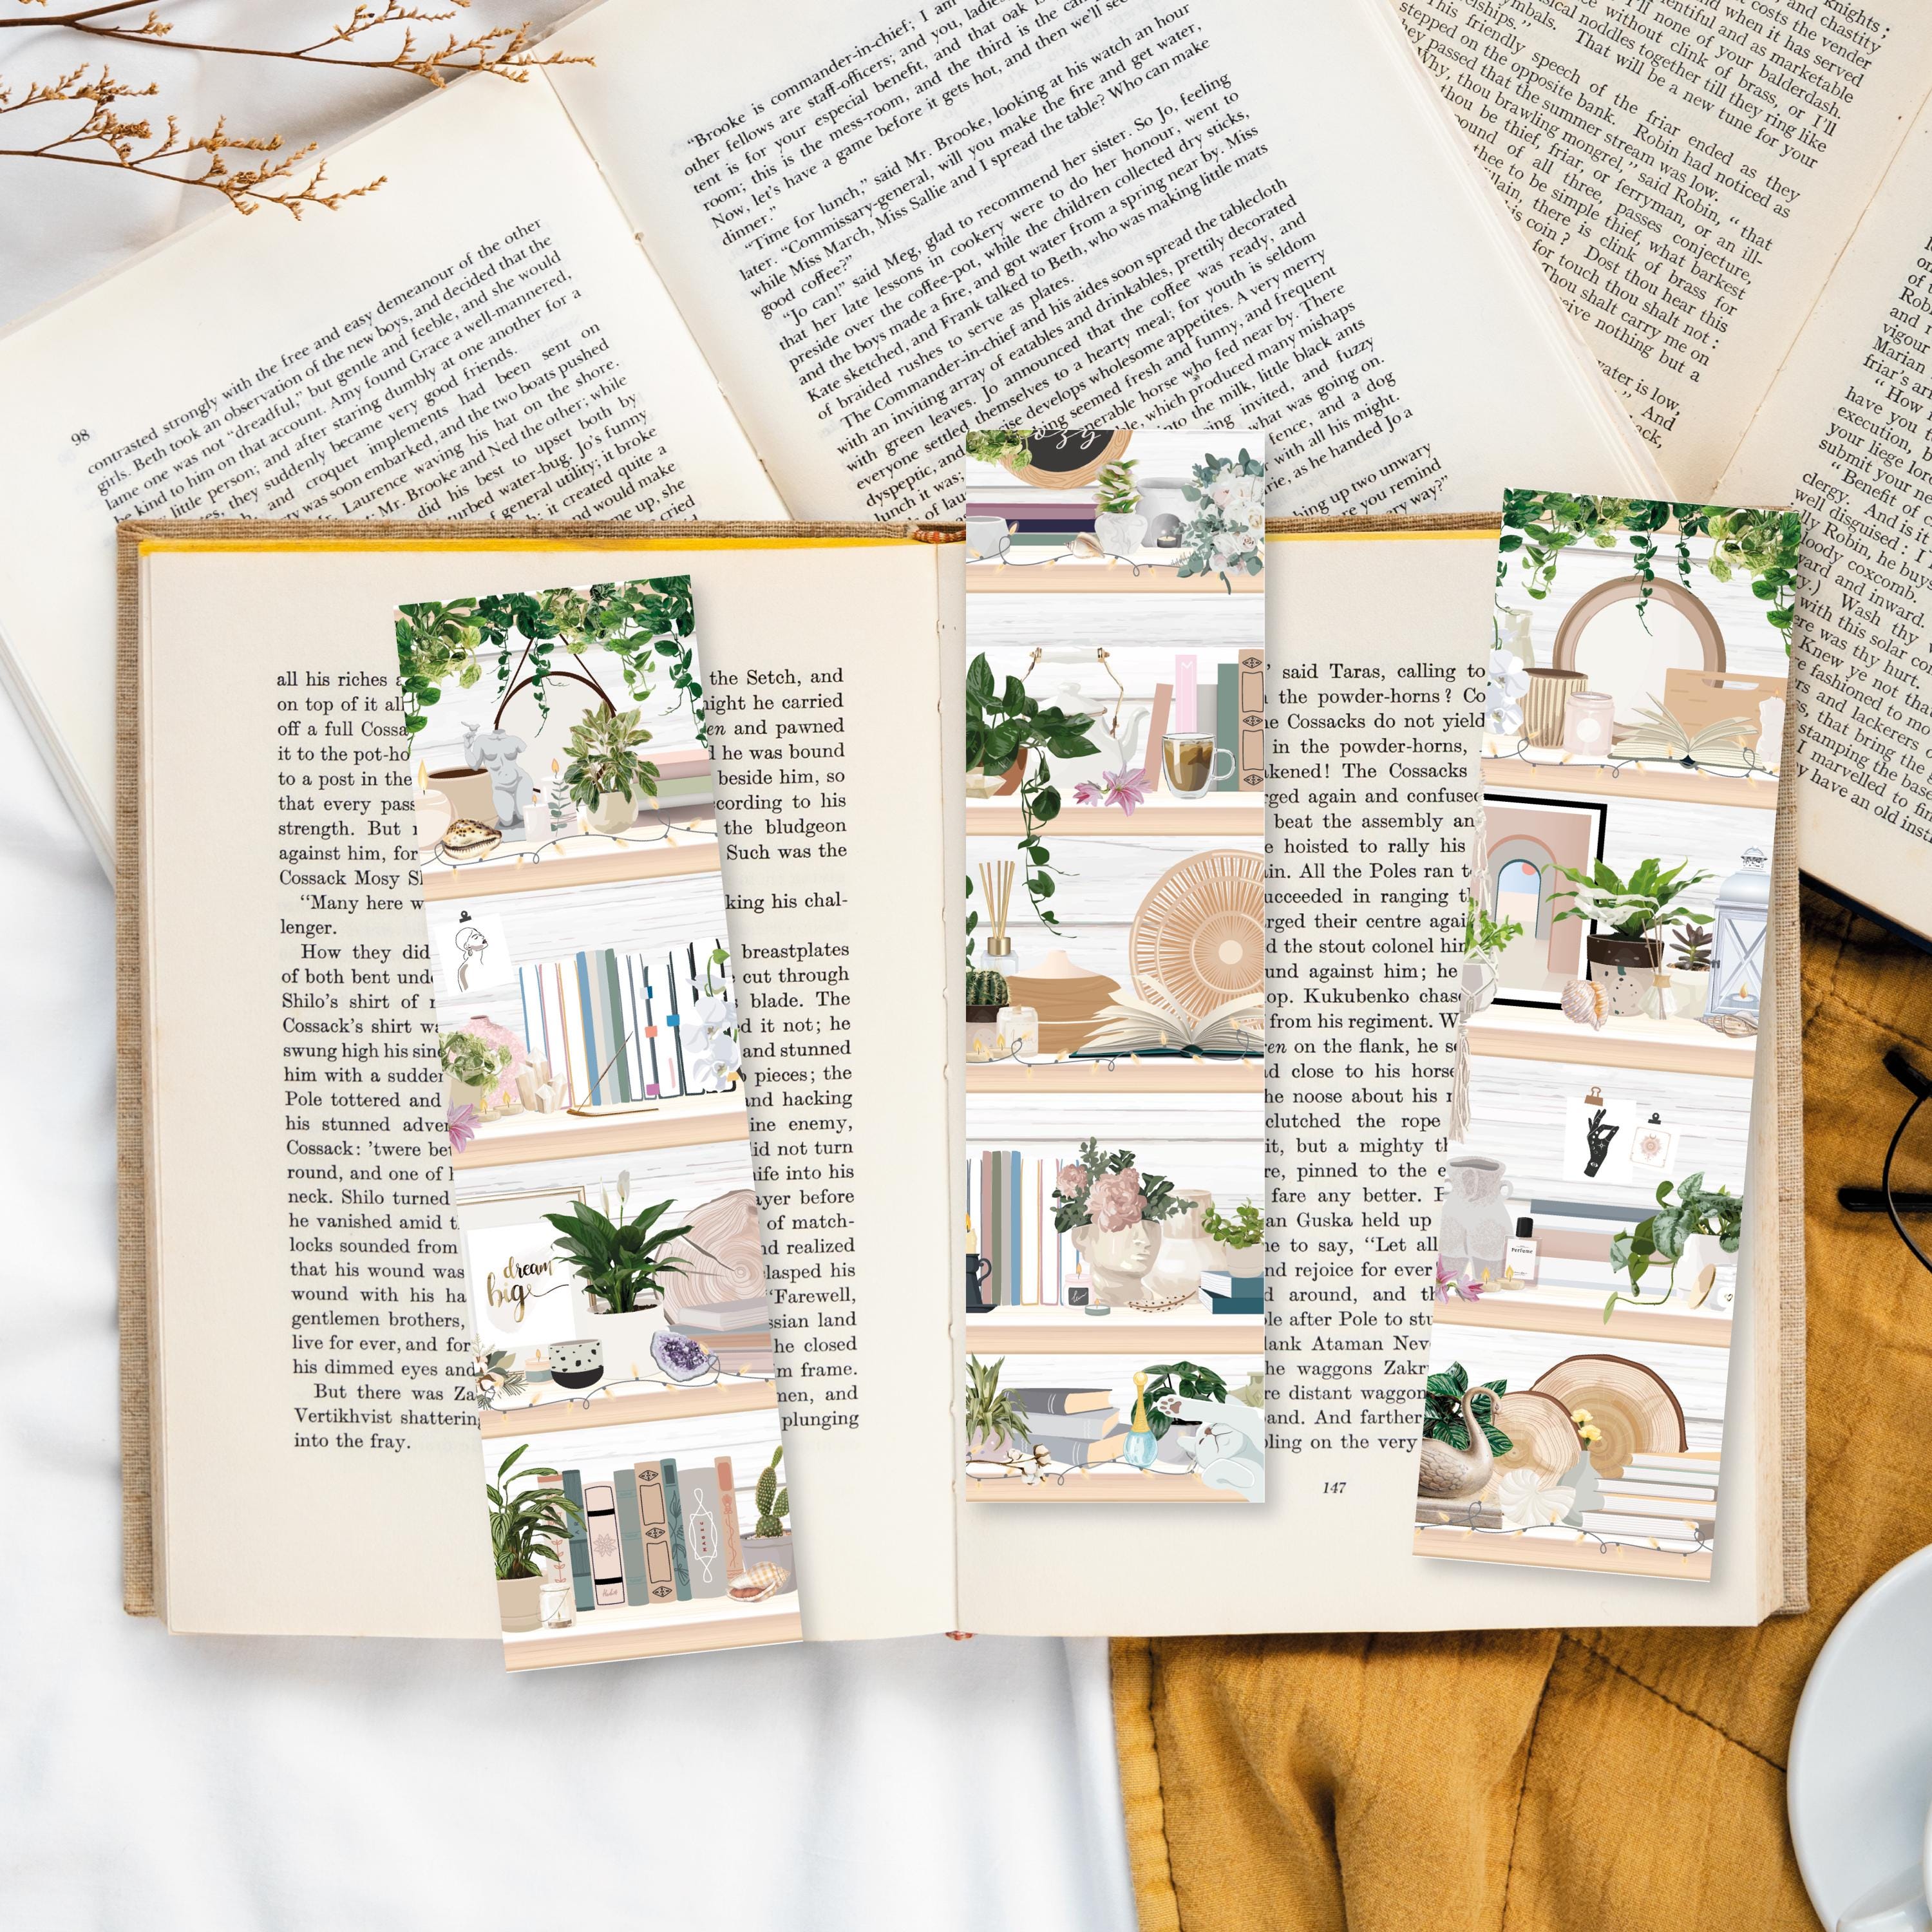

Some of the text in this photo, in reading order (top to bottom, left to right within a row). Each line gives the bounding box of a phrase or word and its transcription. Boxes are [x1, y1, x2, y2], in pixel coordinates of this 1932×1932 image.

[1758, 63, 1841, 119] balderdash.
[793, 211, 815, 229] for
[874, 160, 902, 185] said
[903, 149, 933, 167] Mr.
[933, 117, 992, 151] Brooke,
[990, 84, 1048, 119] looking
[1049, 73, 1065, 88] at
[1065, 61, 1088, 78] his
[1090, 35, 1132, 64] watch
[1135, 25, 1154, 41] an
[1153, 3, 1189, 29] hour
[1531, 52, 1801, 203] speech of the friar ended as they
[1511, 62, 1791, 218] opposite bank. Robin had noticed as
[1508, 163, 1746, 300] to be simple thief, what barkest
[761, 287, 796, 320] good
[88, 218, 541, 475] contrasted strongly with the free and easy demeanour of the other
[806, 272, 1029, 402] Kate sketched, and Frank talked
[424, 347, 518, 407] good friends.
[839, 323, 1018, 428] The Commander-in-chief
[1269, 371, 1396, 446] fence, and a dog
[1844, 385, 1918, 434] have you
[71, 428, 90, 446] 98
[846, 398, 977, 471] with green leaves.
[1825, 422, 1904, 468] your liege
[1329, 442, 1431, 504] up two unwary
[1818, 439, 1913, 493] submit your
[1847, 560, 1917, 603] coxcomb.
[1835, 574, 1925, 629] and inward.
[276, 670, 388, 687] all his riches
[709, 667, 844, 687] the Setch, and
[1282, 662, 1486, 683] said Taras, calling to
[1809, 663, 1884, 712] fashioned
[276, 696, 378, 715] on top of it
[753, 692, 844, 710] he carried
[734, 717, 845, 739] and pawned
[1287, 712, 1486, 732] Cossacks do not yield
[1272, 737, 1468, 758] in the powder-horns,
[1797, 724, 1870, 770] stamping
[278, 770, 413, 790] to a post in the
[717, 768, 846, 786] beside him, so
[1810, 751, 1888, 797] marvelled
[279, 844, 419, 865] against him, for
[1283, 837, 1466, 858] hoisted to rally his
[279, 869, 401, 890] Cossack Mosy
[366, 895, 403, 910] here
[280, 918, 337, 939] lenger.
[741, 941, 849, 962] breastplates
[754, 1065, 852, 1088] pieces; the
[788, 1119, 853, 1134] enemy,
[288, 1211, 442, 1229] he vanished amid
[766, 1213, 855, 1231] of match-
[289, 1236, 459, 1255] locks sounded from
[290, 1260, 465, 1279] that his wound was
[504, 1256, 554, 1279] dream
[487, 1272, 569, 1323] big
[291, 1309, 465, 1331] gentlemen brothers,
[1289, 1311, 1403, 1326] after Pole to
[1311, 1335, 1384, 1351] Ataman
[800, 1361, 857, 1378] frame.
[293, 1407, 393, 1424] Vertikhvist
[779, 1411, 860, 1432] plunging
[294, 1432, 411, 1454] into the fray.
[1322, 1481, 1347, 1493] 147
